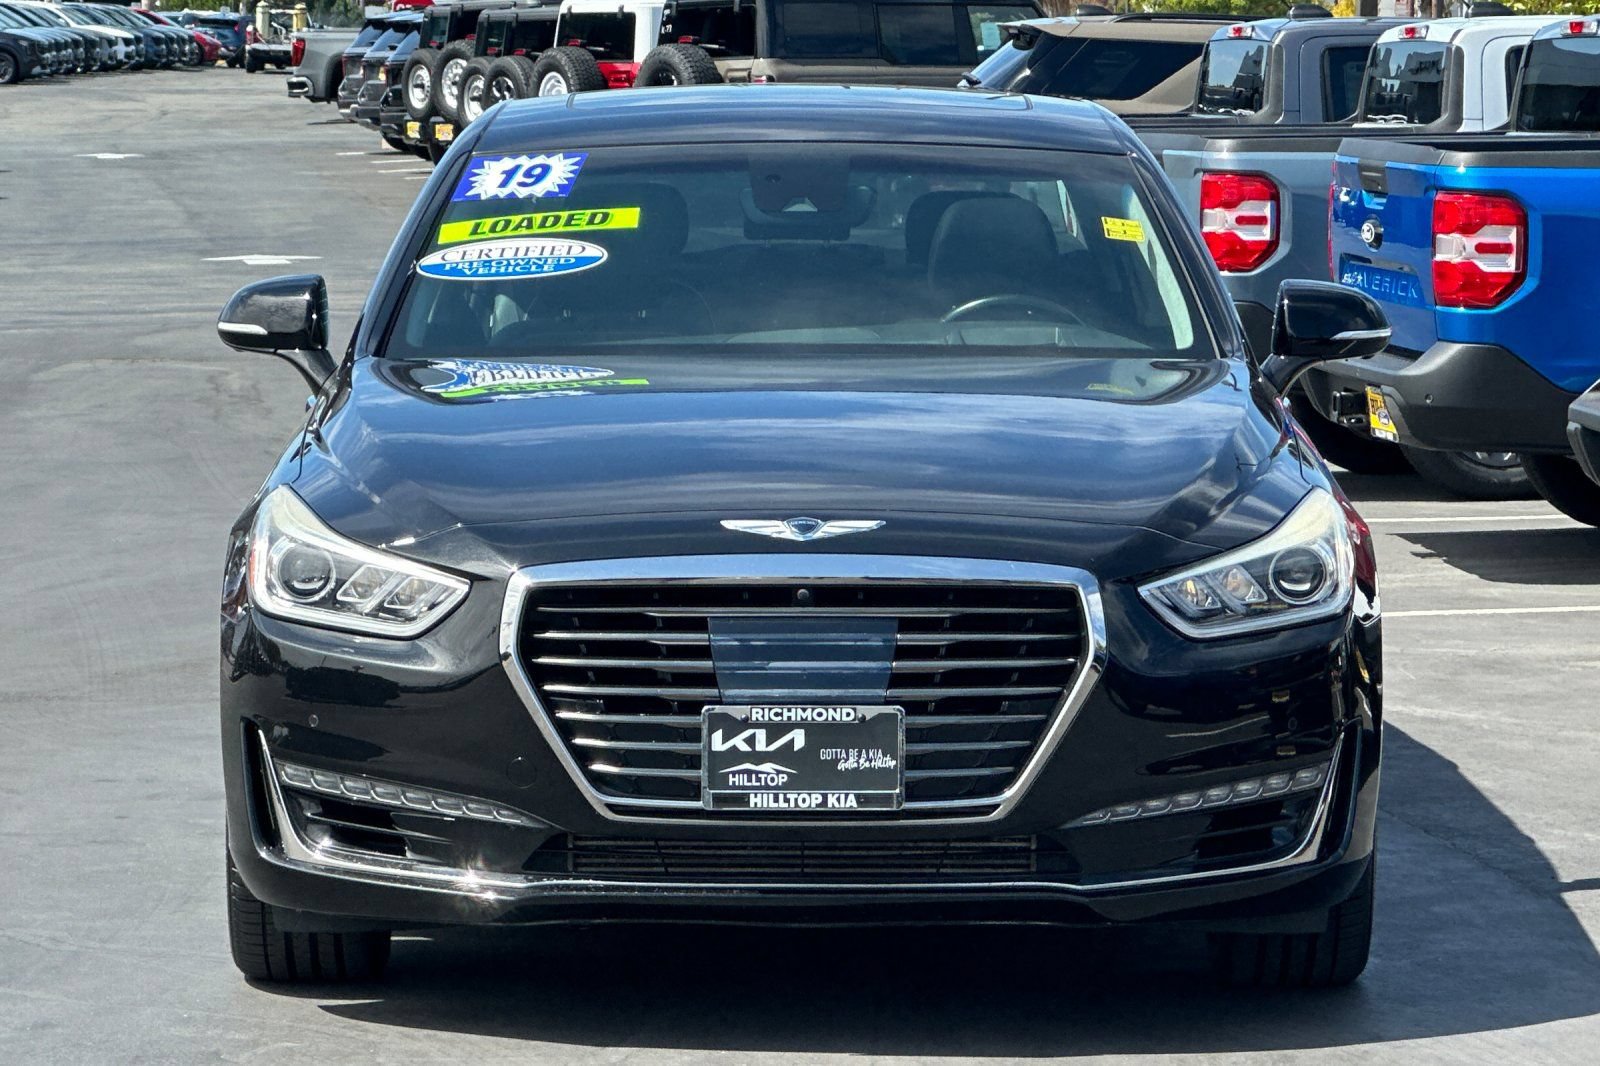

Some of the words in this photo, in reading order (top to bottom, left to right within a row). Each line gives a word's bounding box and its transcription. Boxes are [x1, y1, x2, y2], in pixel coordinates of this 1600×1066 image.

[497, 163, 553, 189] 19
[468, 210, 612, 237] LOADED
[440, 244, 587, 262] CERTIFIED
[443, 256, 576, 271] PRE-OWNED
[461, 264, 556, 275] VEHICLE
[751, 707, 856, 722] RICHMOND
[711, 728, 806, 752] KIA
[820, 748, 847, 760] GOTTA
[848, 748, 859, 760] BE
[861, 748, 867, 760] A
[868, 748, 883, 760] KIA
[728, 773, 788, 786] HILLTOP
[749, 793, 824, 809] HILLTOP
[827, 793, 858, 809] KIA
